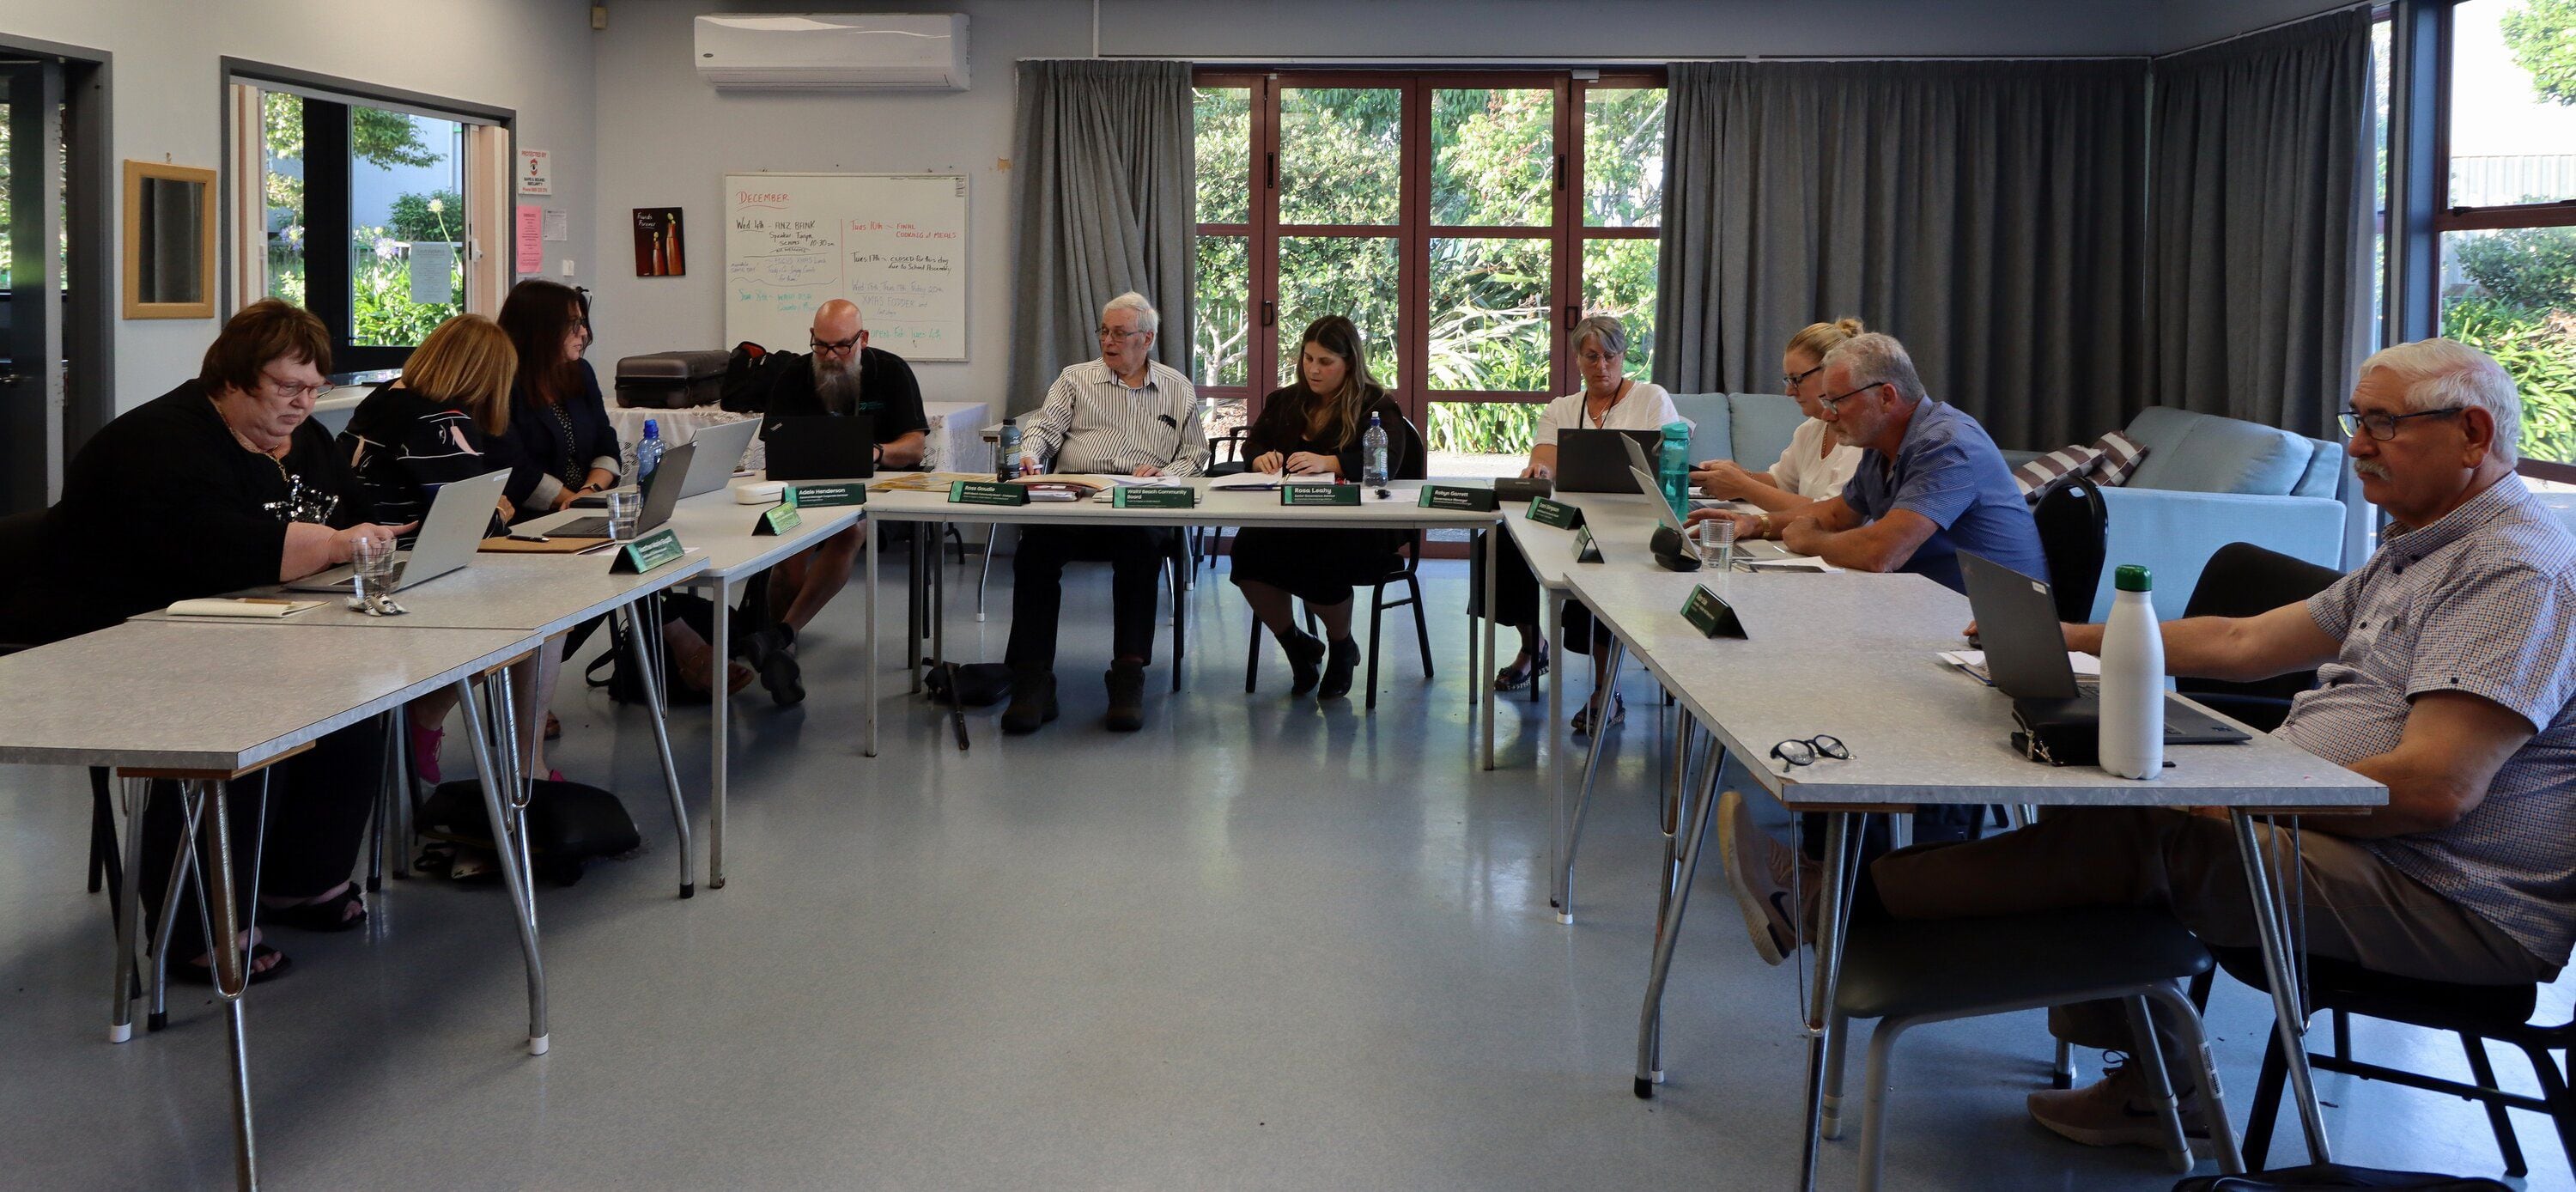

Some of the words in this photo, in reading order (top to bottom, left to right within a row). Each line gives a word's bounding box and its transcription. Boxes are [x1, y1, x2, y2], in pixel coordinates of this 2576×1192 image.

[736, 191, 790, 204] DECEMBER
[736, 216, 750, 230] Wed
[775, 222, 792, 230] ANZ
[794, 220, 816, 230] BANK
[850, 219, 866, 231] Tues
